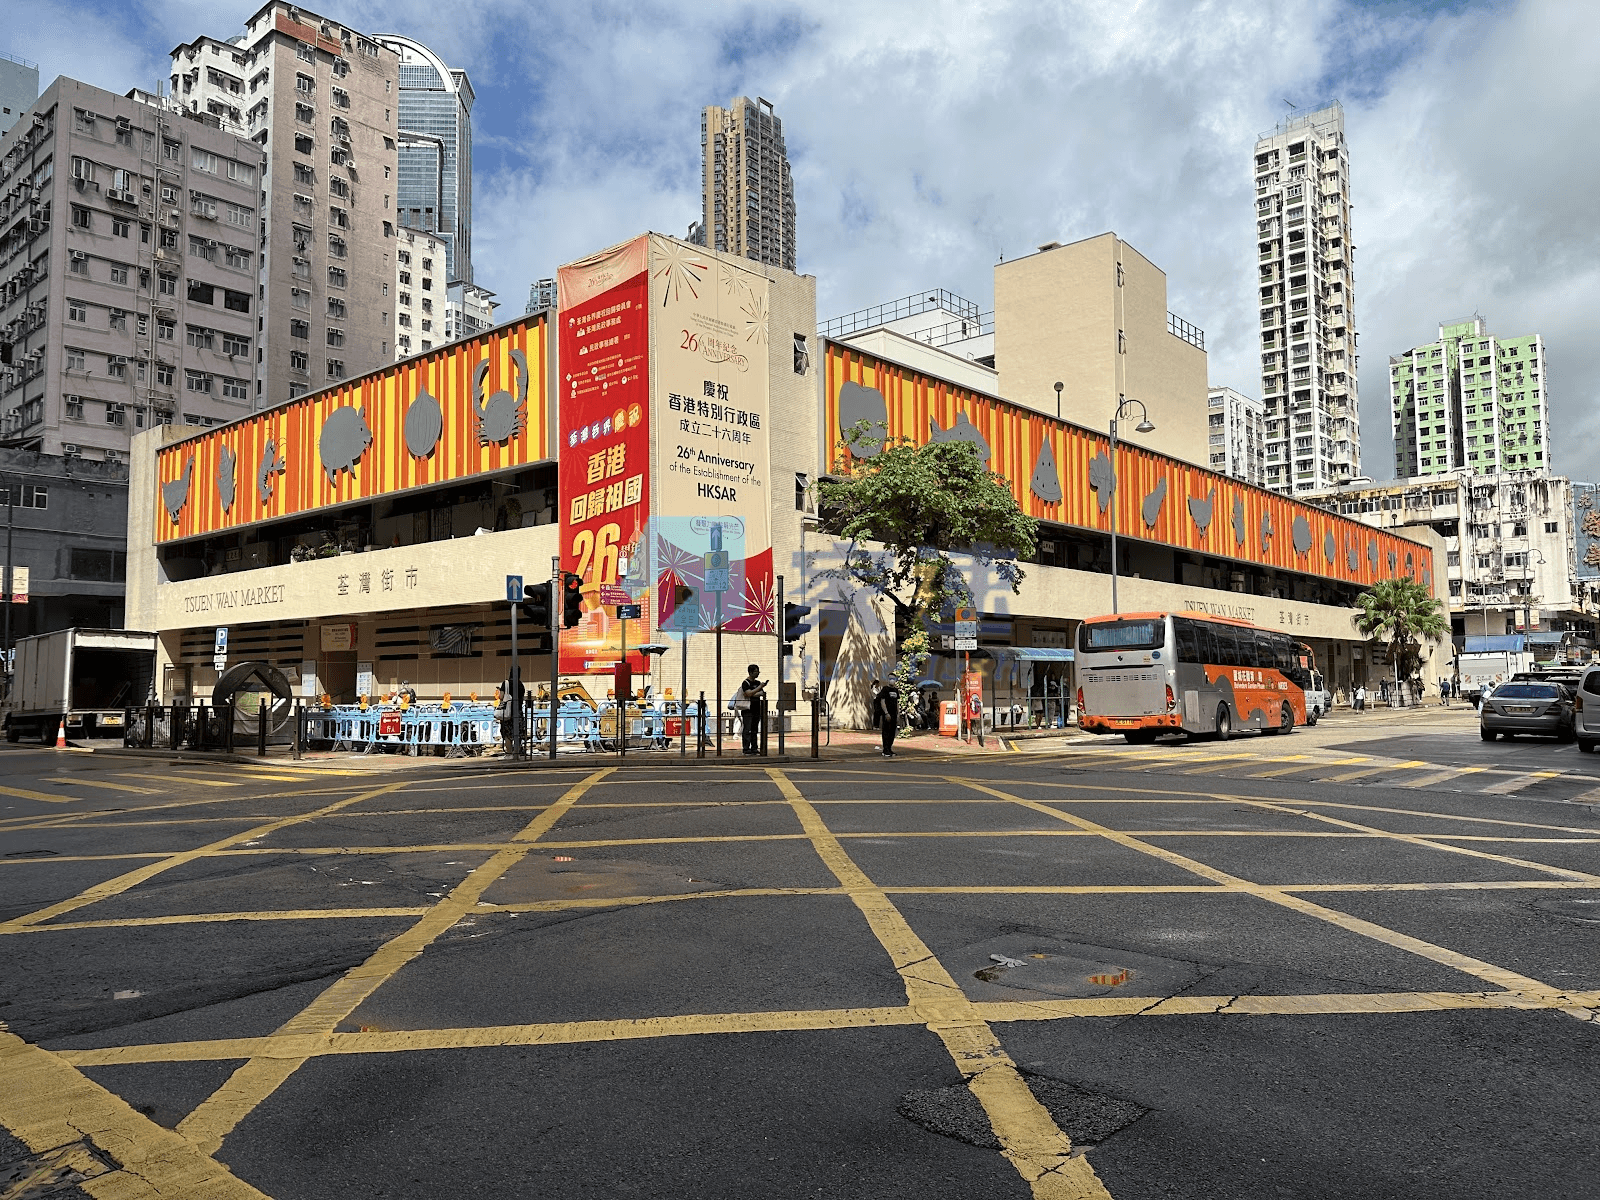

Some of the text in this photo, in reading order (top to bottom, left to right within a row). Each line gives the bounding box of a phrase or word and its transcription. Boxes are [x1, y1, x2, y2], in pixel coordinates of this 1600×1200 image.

[680, 329, 698, 352] 26
[707, 337, 738, 354] 周年紀念
[703, 380, 729, 401] 慶祝
[669, 392, 761, 430] 香港特別行政區
[679, 418, 752, 445] 成立二十六周年
[587, 441, 627, 485] 香港
[676, 445, 755, 475] 26th Anniversary
[669, 462, 761, 487] of the Establishment of the
[569, 473, 643, 526] 回歸祖國
[697, 482, 737, 502] HKSAR
[571, 522, 621, 594] 26
[337, 564, 419, 596] 荃灣街市
[184, 584, 285, 613] TSUEN WAN MARKET
[1184, 600, 1255, 620] TSUEN WAN MARKET
[218, 630, 226, 645] P
